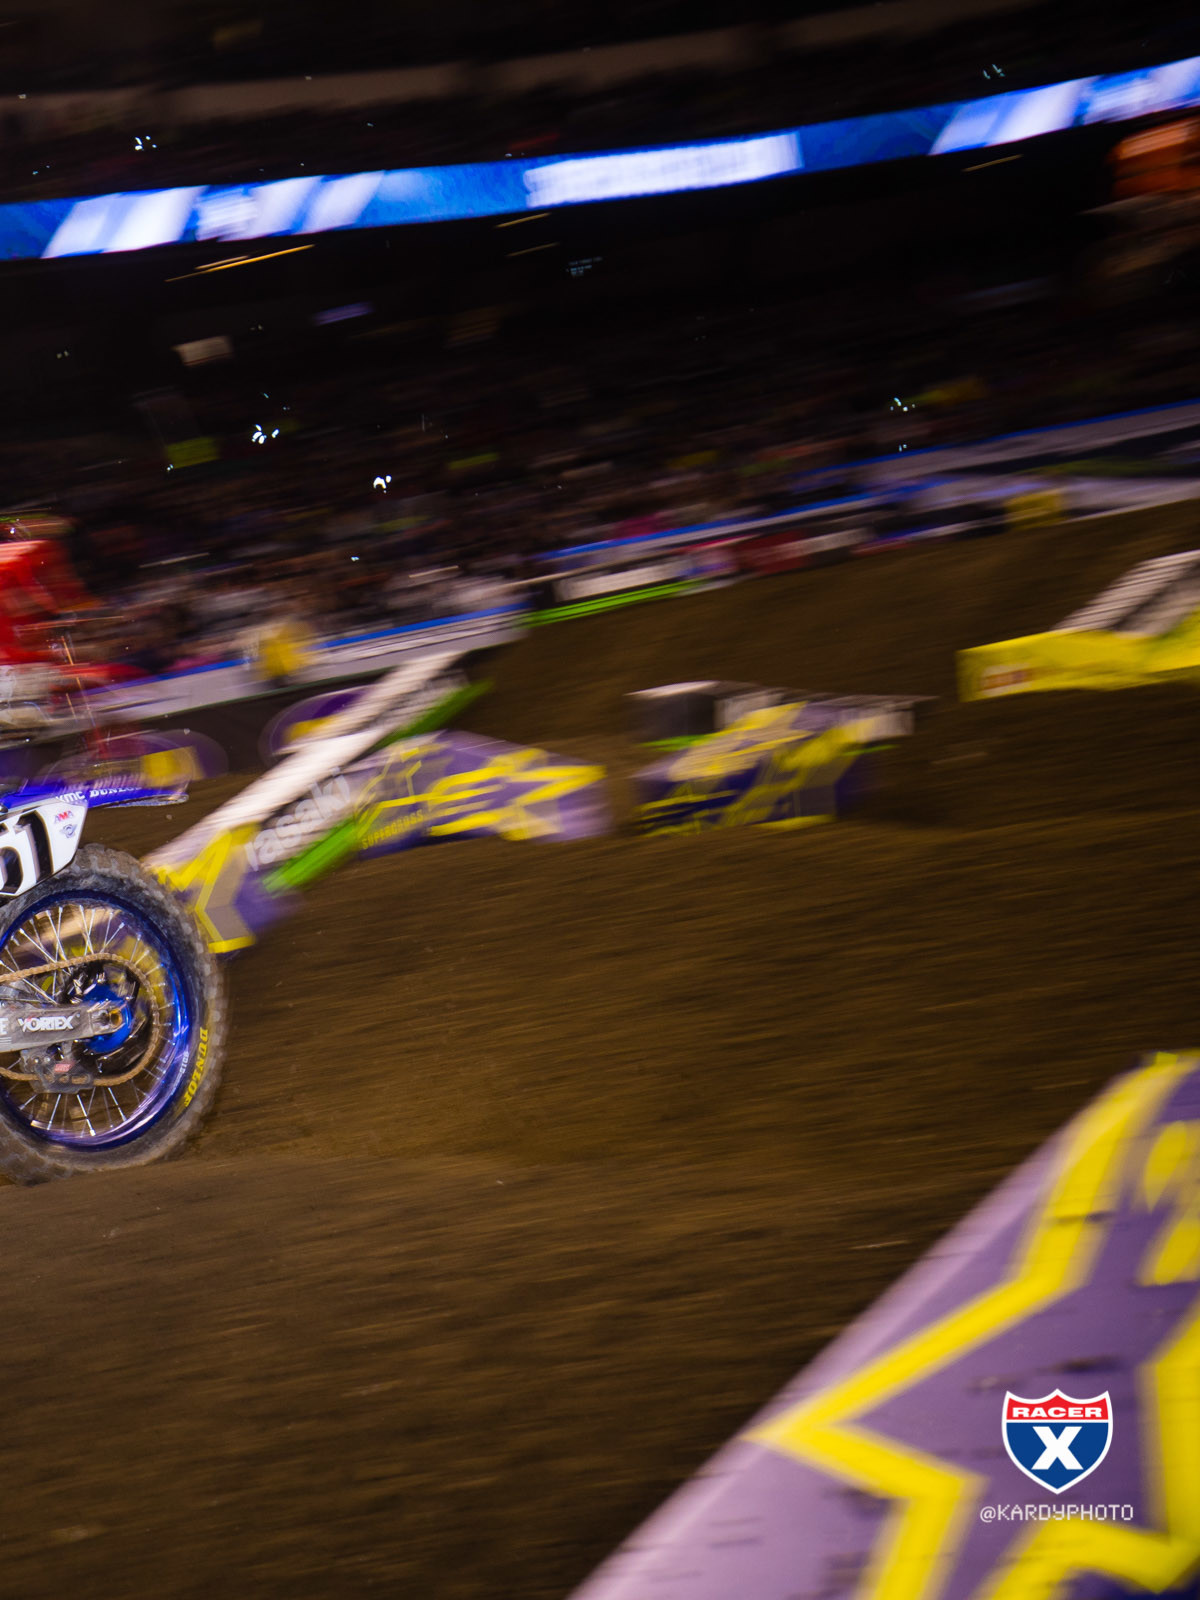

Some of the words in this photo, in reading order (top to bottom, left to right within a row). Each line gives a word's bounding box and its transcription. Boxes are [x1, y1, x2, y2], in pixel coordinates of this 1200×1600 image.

[54, 810, 74, 824] AMA
[18, 1015, 75, 1033] VORTEX
[184, 1027, 209, 1107] DUNLOP
